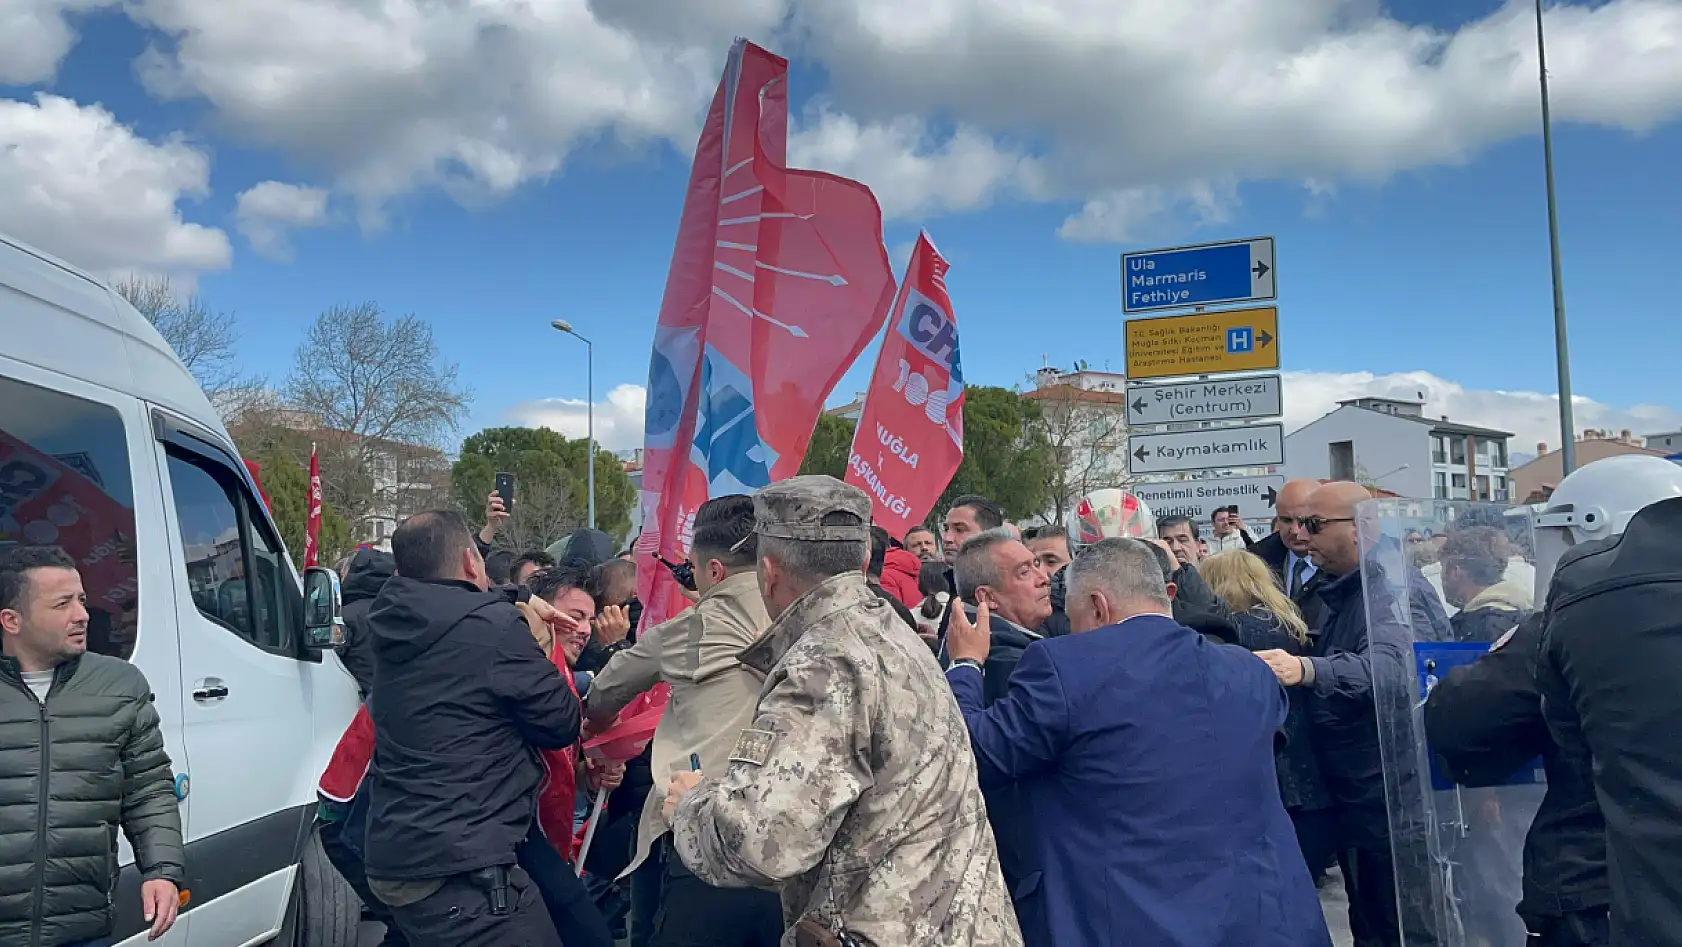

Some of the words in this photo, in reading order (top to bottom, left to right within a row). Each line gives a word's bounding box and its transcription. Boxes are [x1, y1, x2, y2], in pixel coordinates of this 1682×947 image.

[1131, 258, 1155, 271] Ula
[1131, 269, 1207, 287] Marmaris
[1132, 288, 1190, 304] Fethiye
[1149, 328, 1176, 338] Sağlık
[1179, 324, 1220, 334] Bakanlığı
[1132, 338, 1159, 348] Muğla
[1231, 331, 1248, 350] H
[1179, 354, 1222, 364] Hastanesi
[1154, 388, 1196, 402] Şehir
[1203, 382, 1266, 397] Merkezi
[1169, 399, 1252, 418] (Centrum)
[1156, 439, 1268, 460] Kaymakamlık
[850, 453, 911, 519] AŞKANLIĞI
[1196, 484, 1260, 498] Serbestlik
